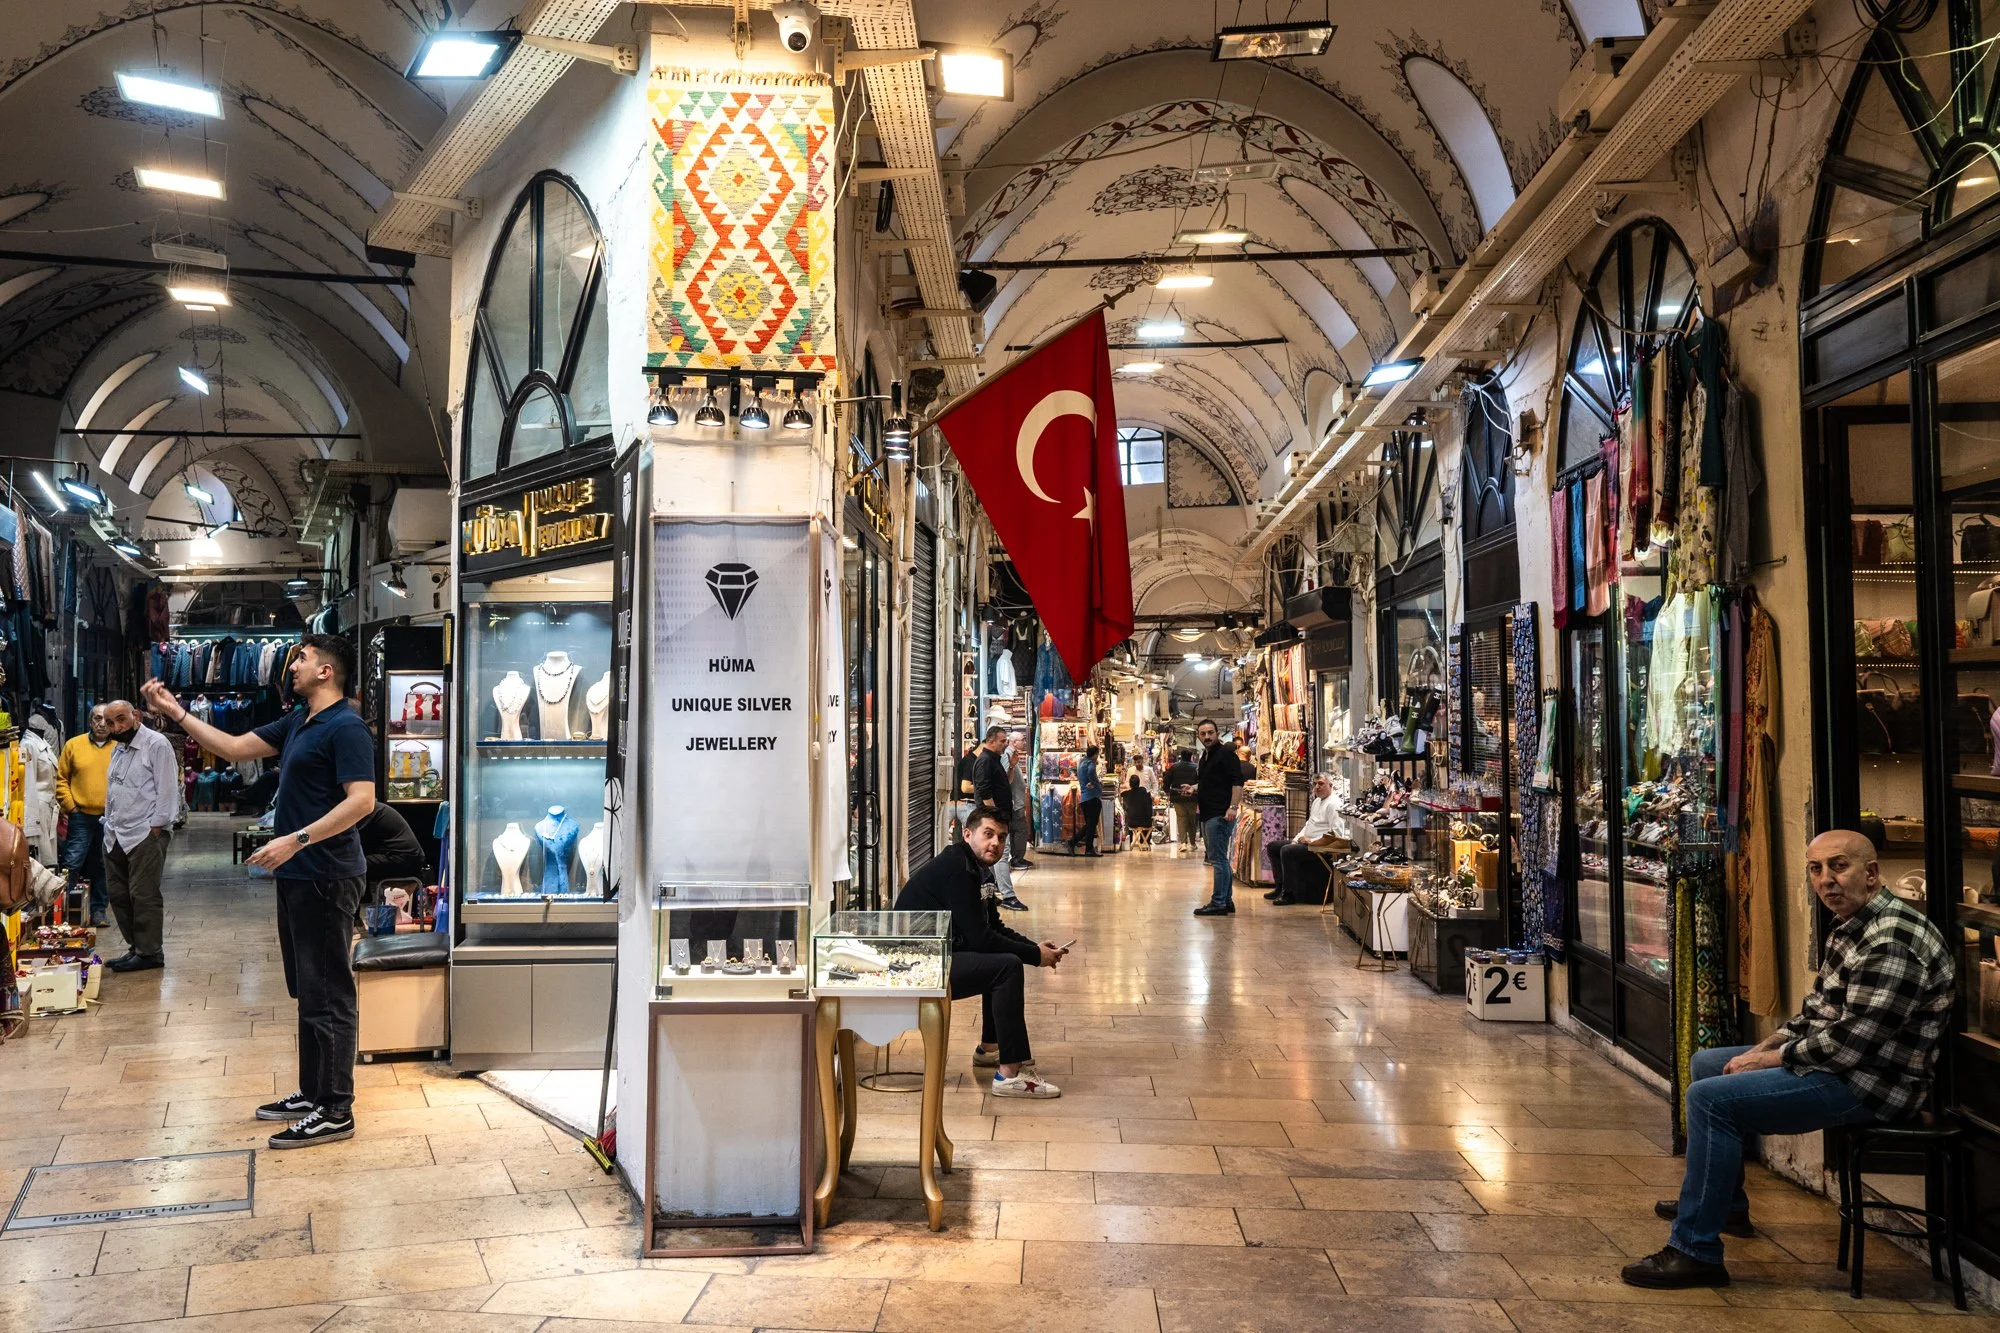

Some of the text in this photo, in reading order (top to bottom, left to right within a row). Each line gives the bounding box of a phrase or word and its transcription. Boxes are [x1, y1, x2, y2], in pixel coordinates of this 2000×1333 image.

[708, 656, 756, 673] HÜMA
[671, 697, 792, 713] UNIQUE SILVER
[685, 736, 778, 751] JEWELLERY
[1484, 966, 1528, 1005] 2€
